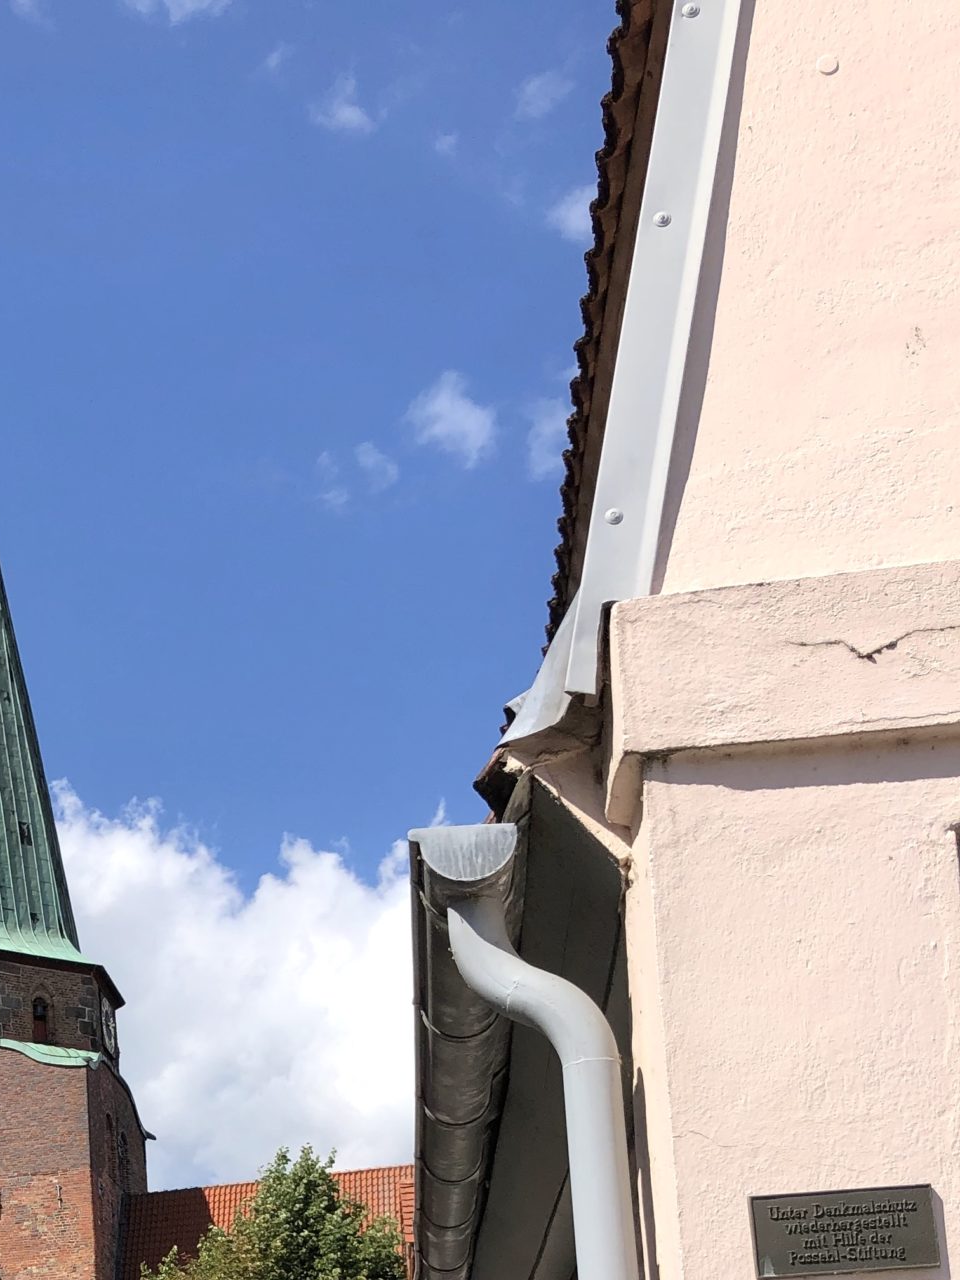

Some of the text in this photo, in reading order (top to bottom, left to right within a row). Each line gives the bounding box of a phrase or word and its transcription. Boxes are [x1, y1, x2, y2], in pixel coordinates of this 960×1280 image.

[767, 1199, 918, 1221] Unter Denkmalschutz
[785, 1213, 908, 1235] wiederhergestellt
[802, 1231, 892, 1250] mit Hilfe der
[788, 1246, 907, 1266] Possehl-Stiftung
